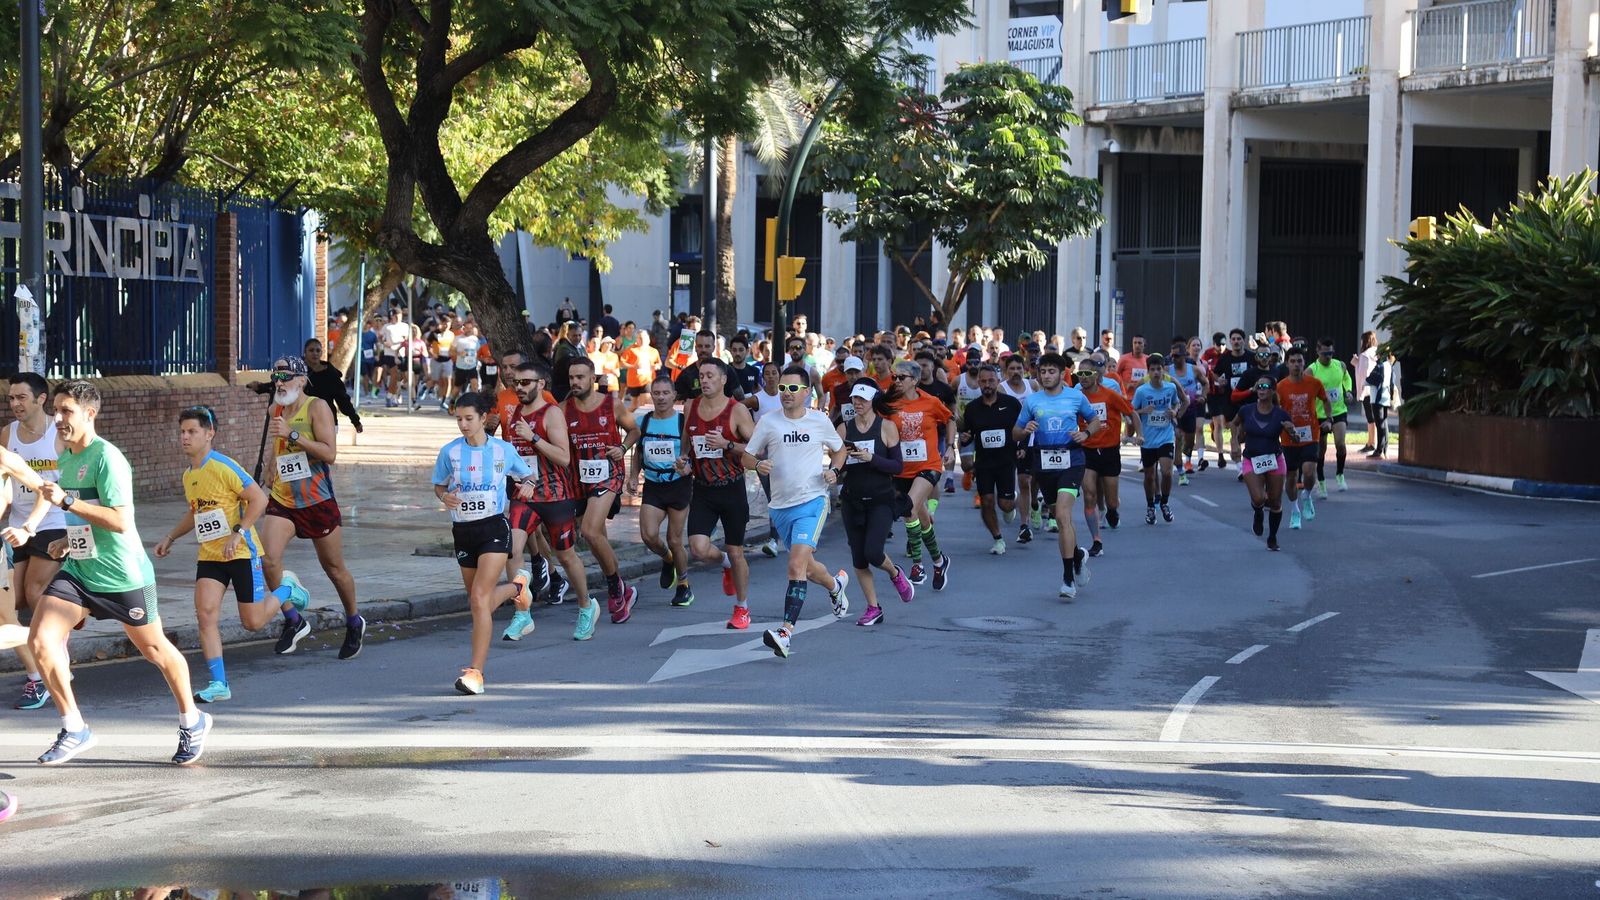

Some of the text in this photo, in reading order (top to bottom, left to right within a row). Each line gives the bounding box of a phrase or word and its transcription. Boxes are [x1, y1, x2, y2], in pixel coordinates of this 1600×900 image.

[1008, 25, 1055, 38] CORNER VIP
[1008, 38, 1054, 51] MALAGUISTA
[783, 431, 810, 443] nike
[985, 435, 1001, 443] 606
[648, 447, 672, 455] 1055
[905, 448, 918, 456] 91
[1049, 455, 1062, 463] 40
[1256, 459, 1273, 469] 242
[280, 462, 302, 474] 281
[582, 467, 602, 476] 787
[461, 500, 486, 512] 938
[197, 520, 221, 534] 299
[69, 537, 87, 550] 62
